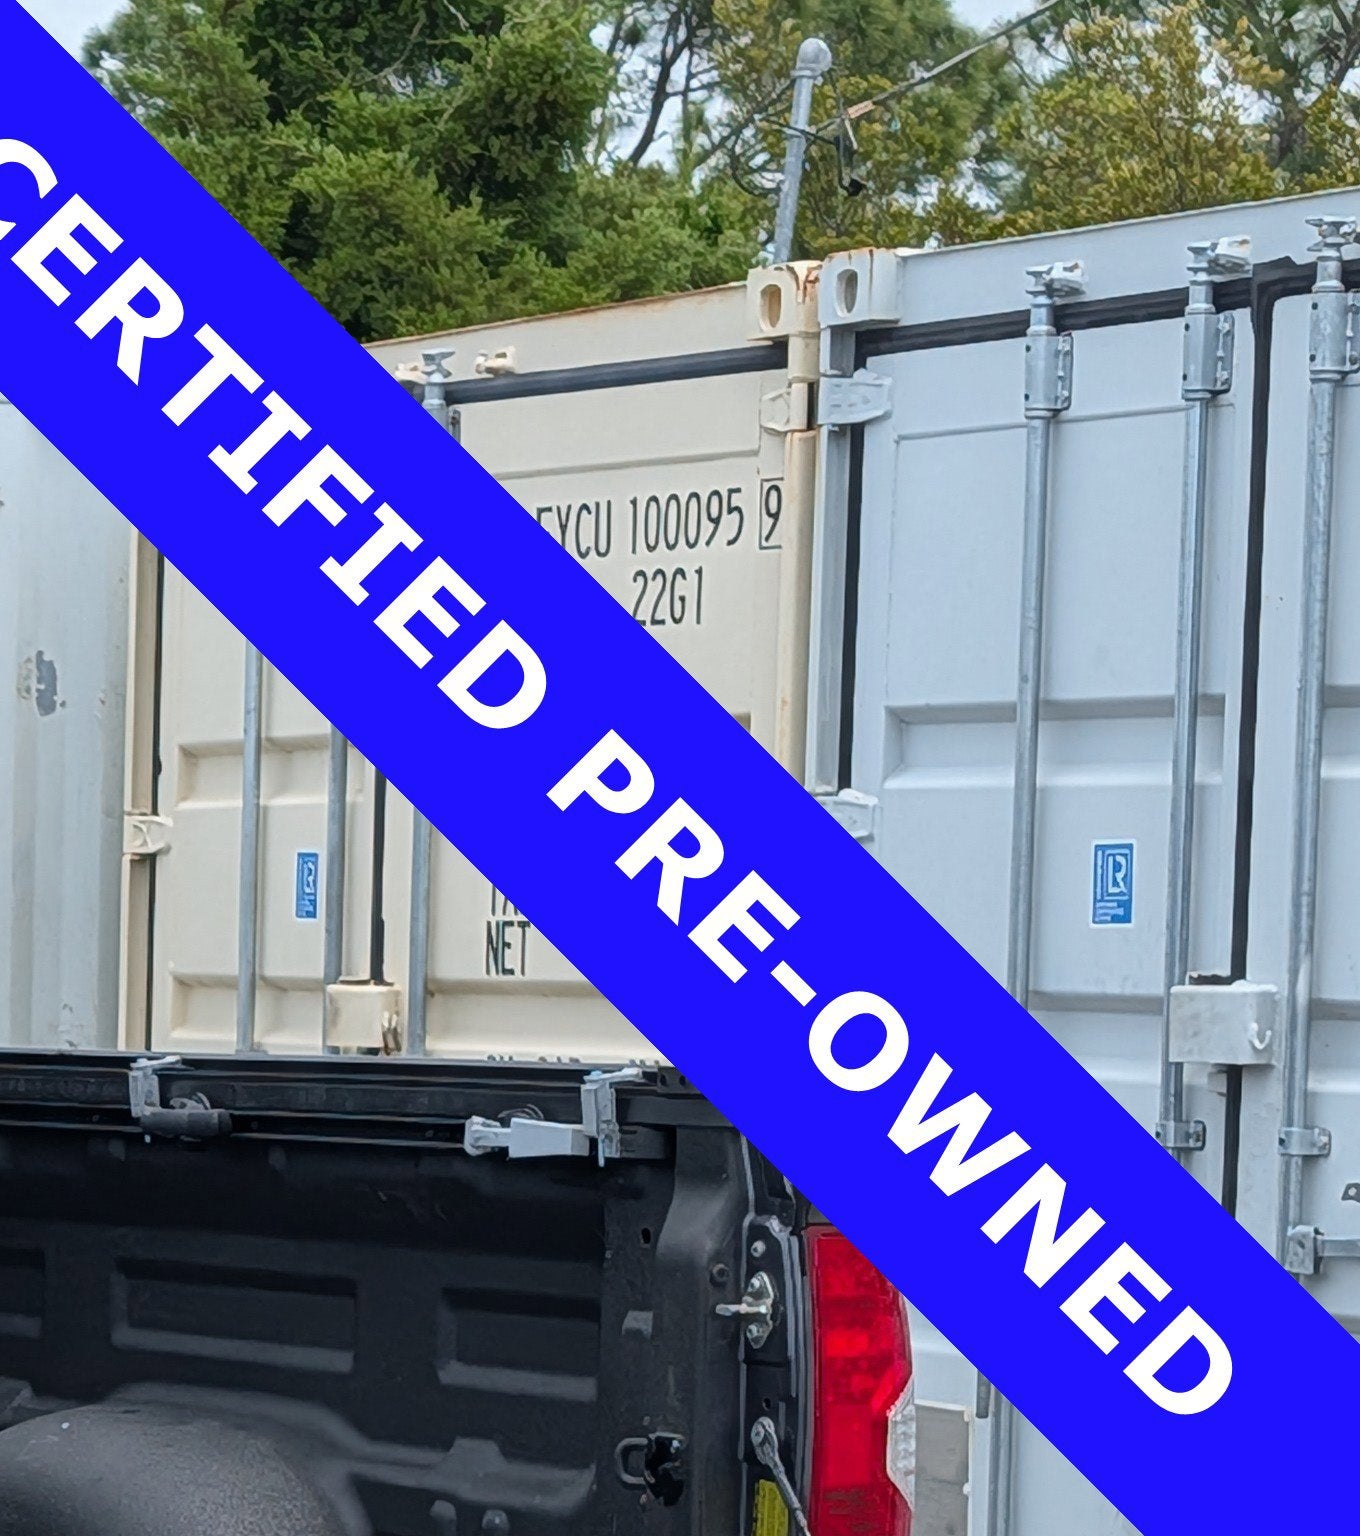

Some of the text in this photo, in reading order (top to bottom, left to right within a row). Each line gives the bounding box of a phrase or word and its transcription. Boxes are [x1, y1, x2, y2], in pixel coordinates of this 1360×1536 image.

[630, 487, 745, 554] 100095
[763, 482, 783, 544] 9
[632, 565, 704, 627] 22G1
[486, 920, 531, 977] NET
